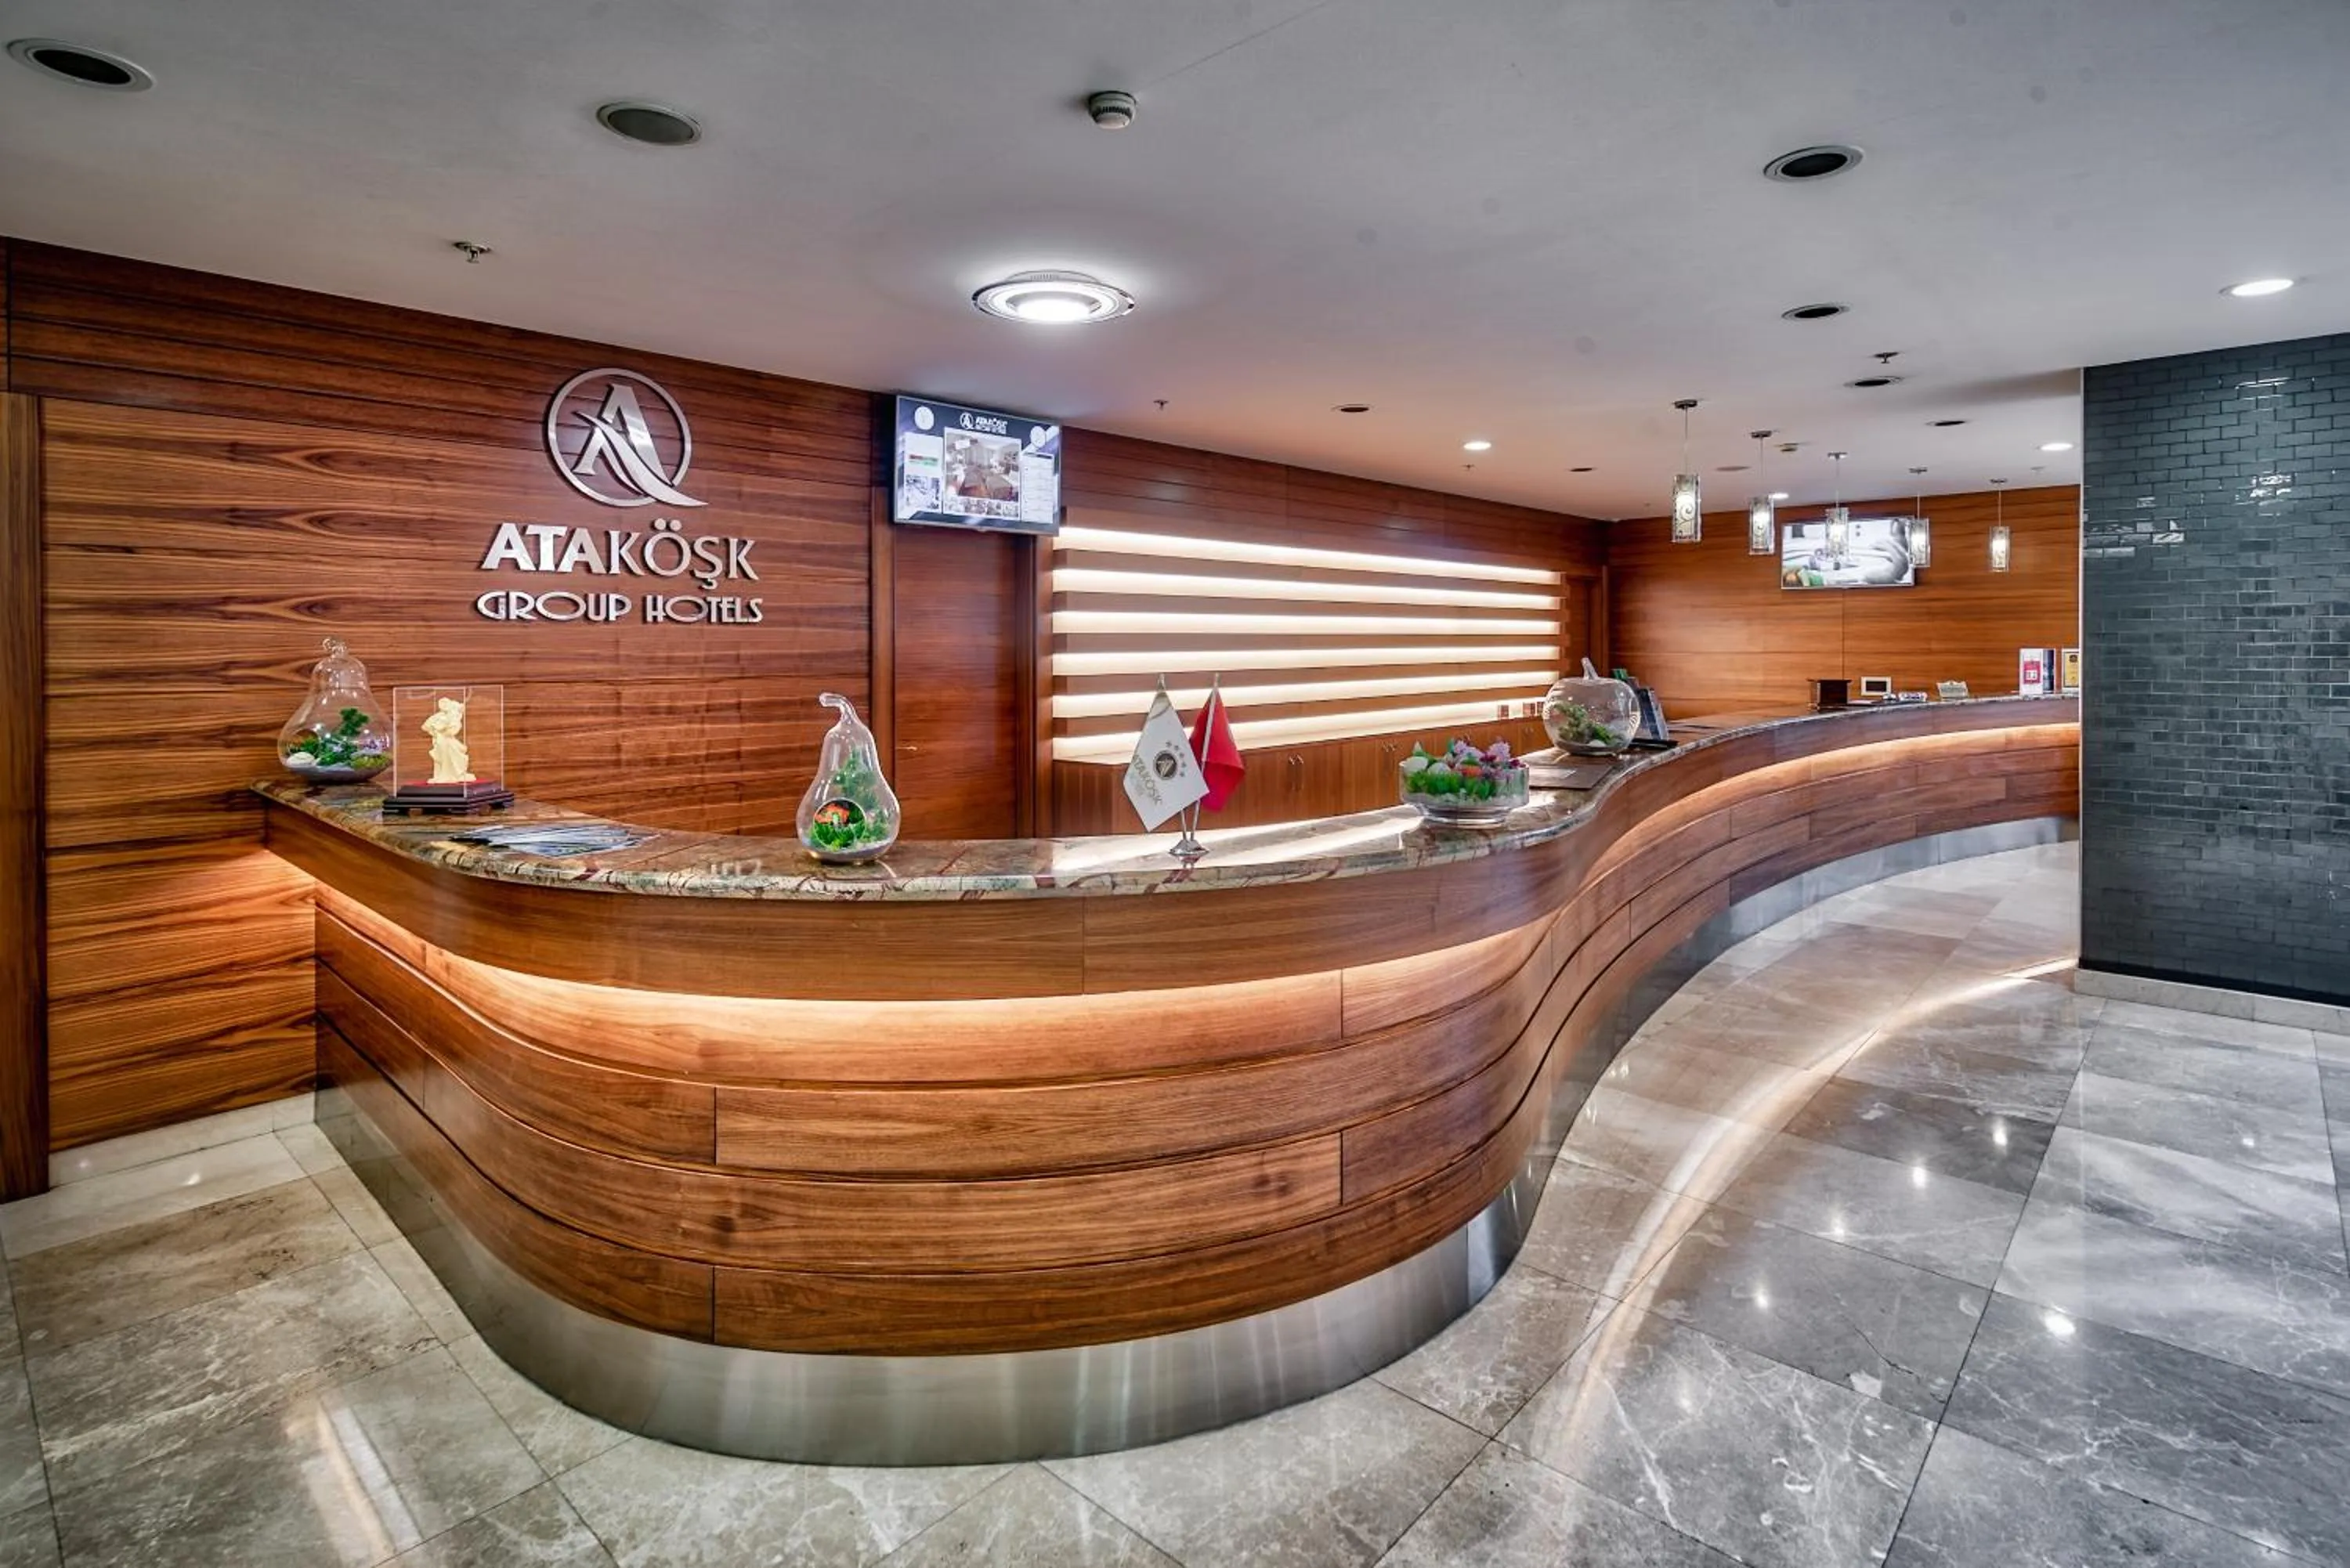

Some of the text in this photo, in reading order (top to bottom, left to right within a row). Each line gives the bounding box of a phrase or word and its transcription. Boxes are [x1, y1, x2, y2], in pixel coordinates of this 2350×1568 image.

[480, 518, 759, 590] ATAKÖŞK
[476, 591, 764, 623] GROUP HOTELS
